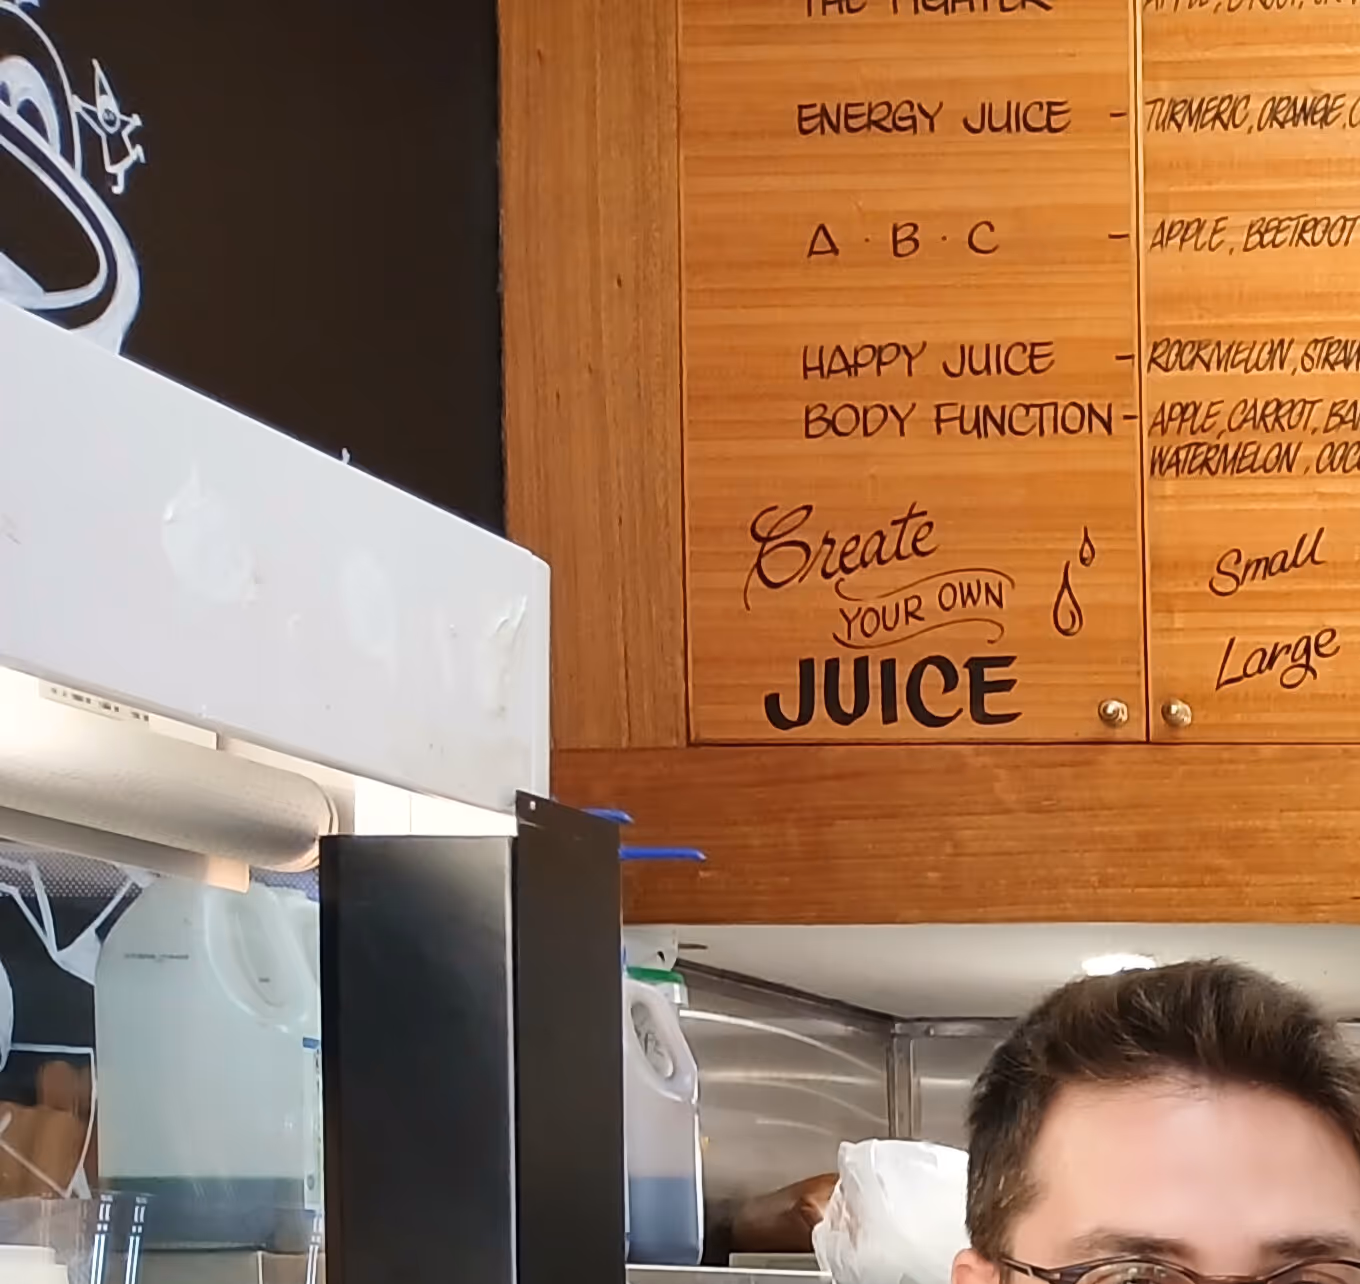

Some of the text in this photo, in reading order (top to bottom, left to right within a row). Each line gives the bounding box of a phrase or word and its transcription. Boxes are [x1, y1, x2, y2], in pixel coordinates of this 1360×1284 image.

[798, 100, 1071, 135] ENERGY JUICE
[1146, 95, 1254, 134] TURMERIC,
[1150, 216, 1235, 256] APPLE,
[802, 342, 1055, 379] HAPPY JUICE
[1147, 337, 1297, 377] ROCKMELON,
[805, 402, 916, 438] BODY
[744, 502, 938, 611] Create
[1209, 527, 1326, 597] Small
[840, 580, 1004, 641] YOUR OWN
[1216, 627, 1341, 691] Large
[764, 655, 1022, 731] JUICE
